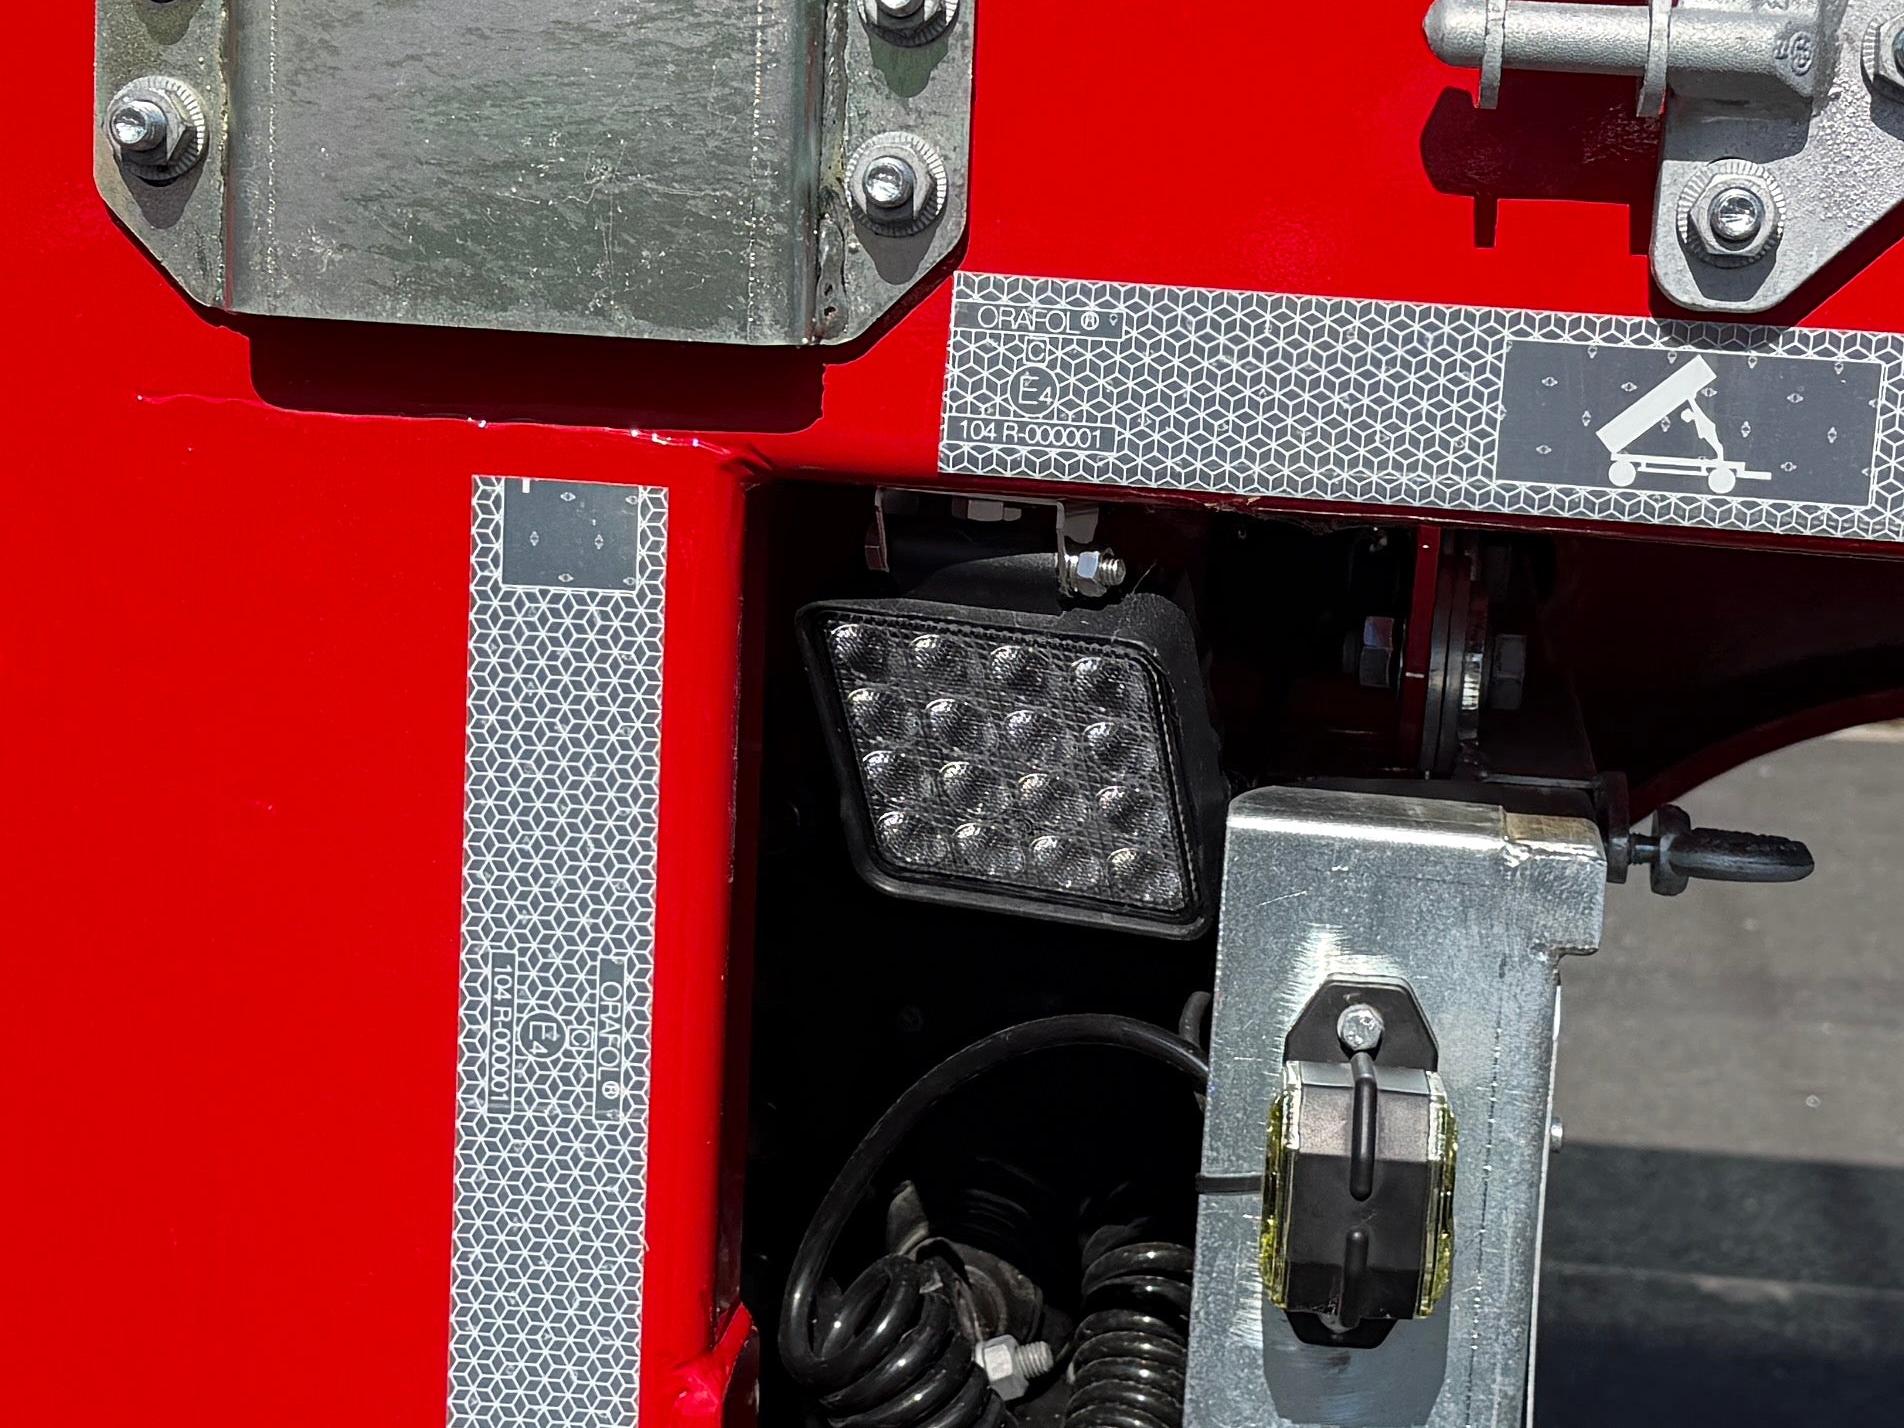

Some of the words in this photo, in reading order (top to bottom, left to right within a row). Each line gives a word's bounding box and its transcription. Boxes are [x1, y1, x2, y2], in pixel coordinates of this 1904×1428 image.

[960, 419, 996, 441] 104
[1003, 421, 1101, 449] R-000001
[493, 964, 513, 1001] 104
